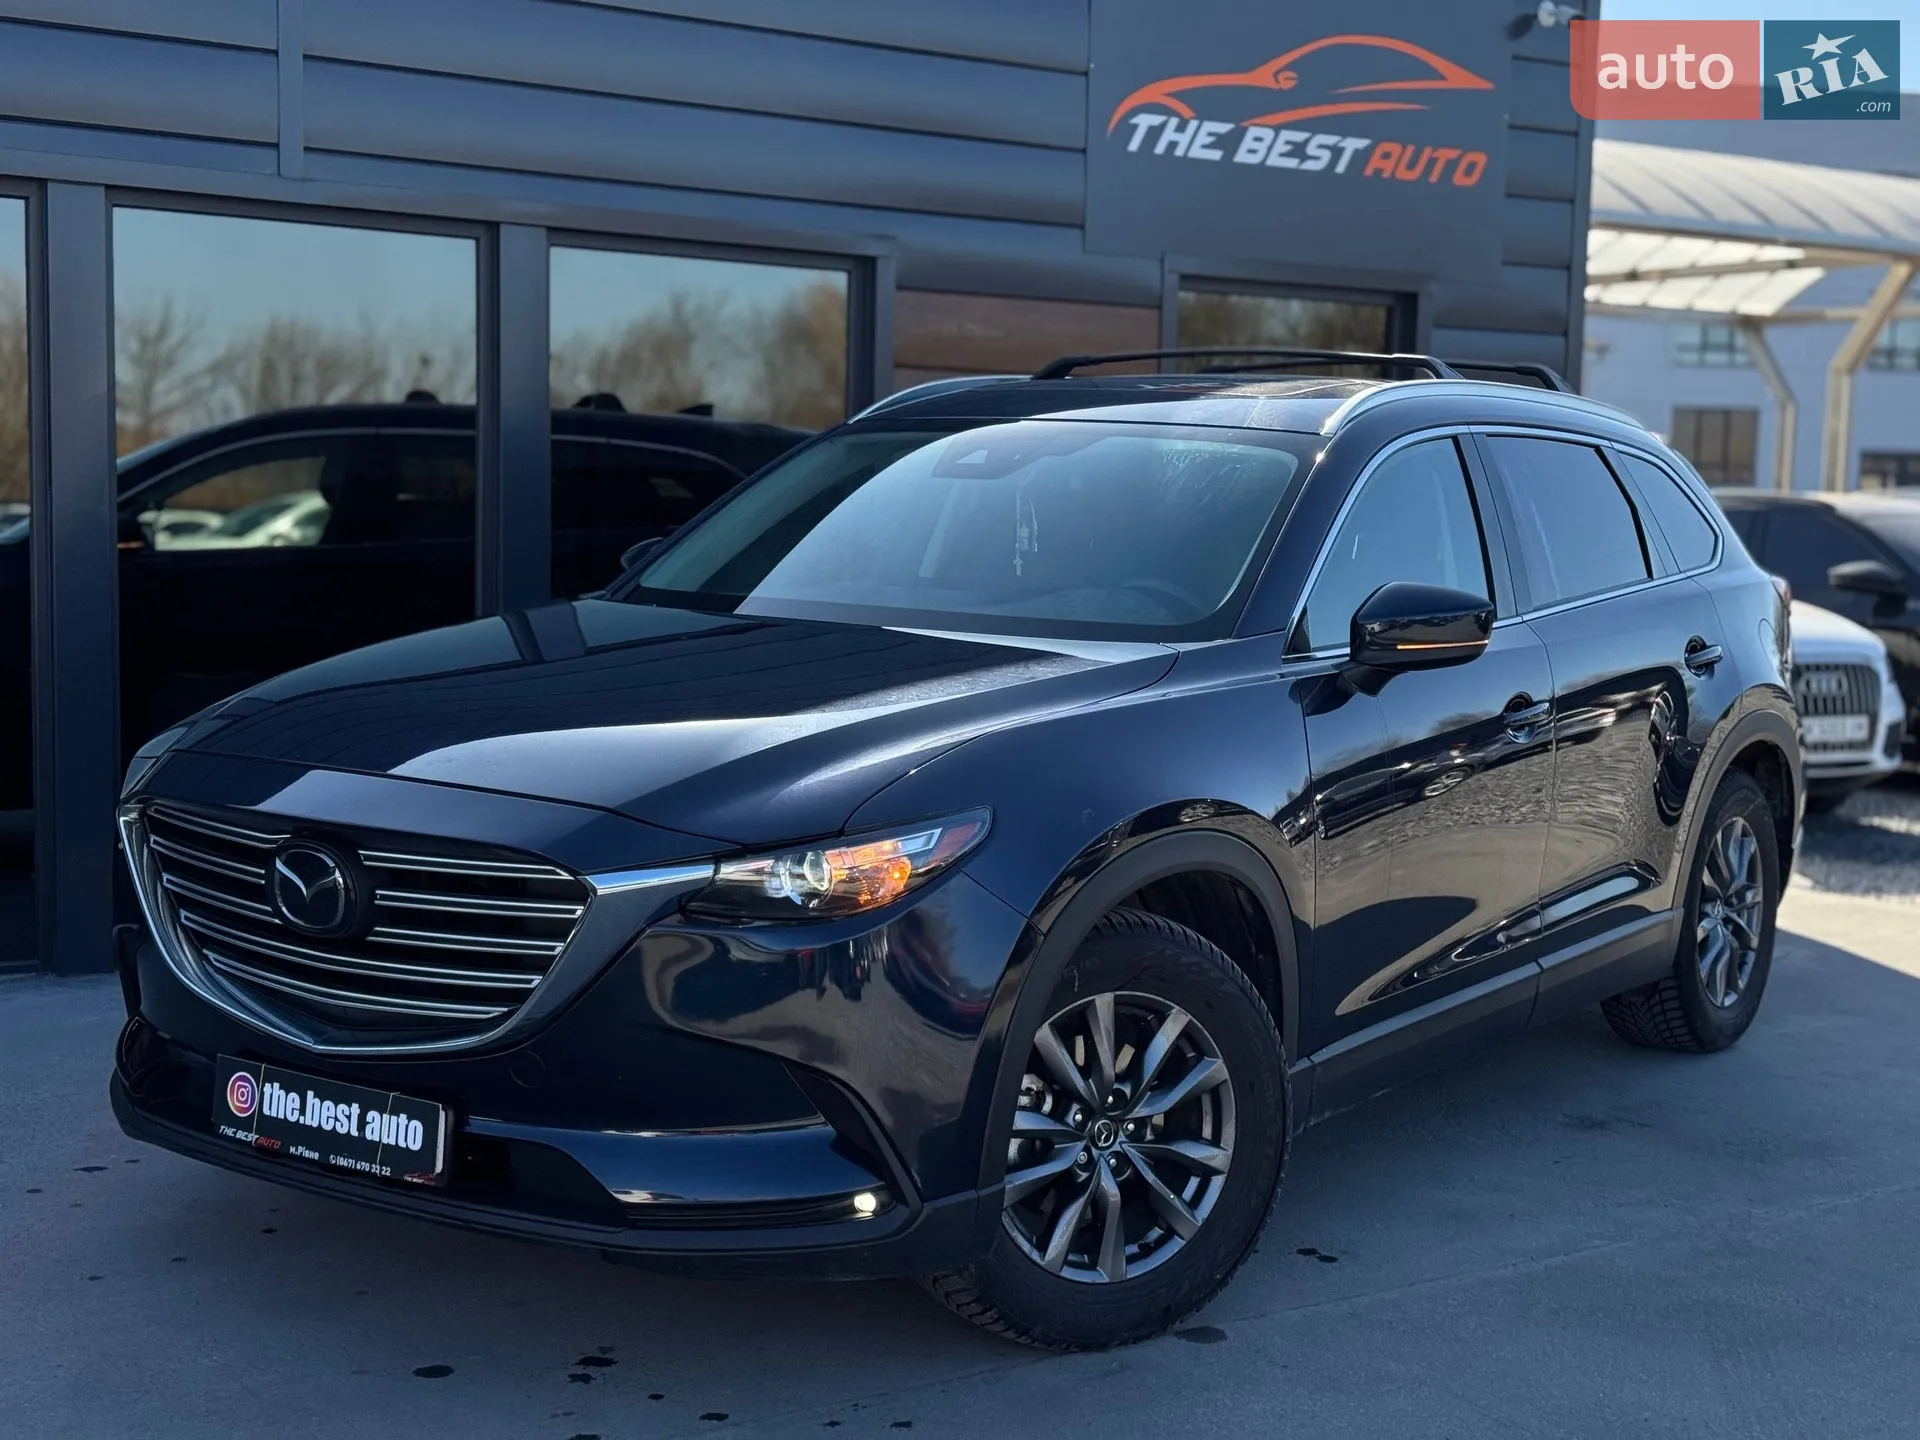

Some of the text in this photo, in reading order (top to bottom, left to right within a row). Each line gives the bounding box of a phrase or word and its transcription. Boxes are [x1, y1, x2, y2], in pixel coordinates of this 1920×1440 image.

[1126, 112, 1488, 187] THE BEST AUTO
[218, 1124, 282, 1149] THE BEST AUTO
[262, 1082, 424, 1151] the.best auto
[356, 1160, 370, 1172] 670
[371, 1163, 380, 1174] 33
[381, 1166, 391, 1176] 22
